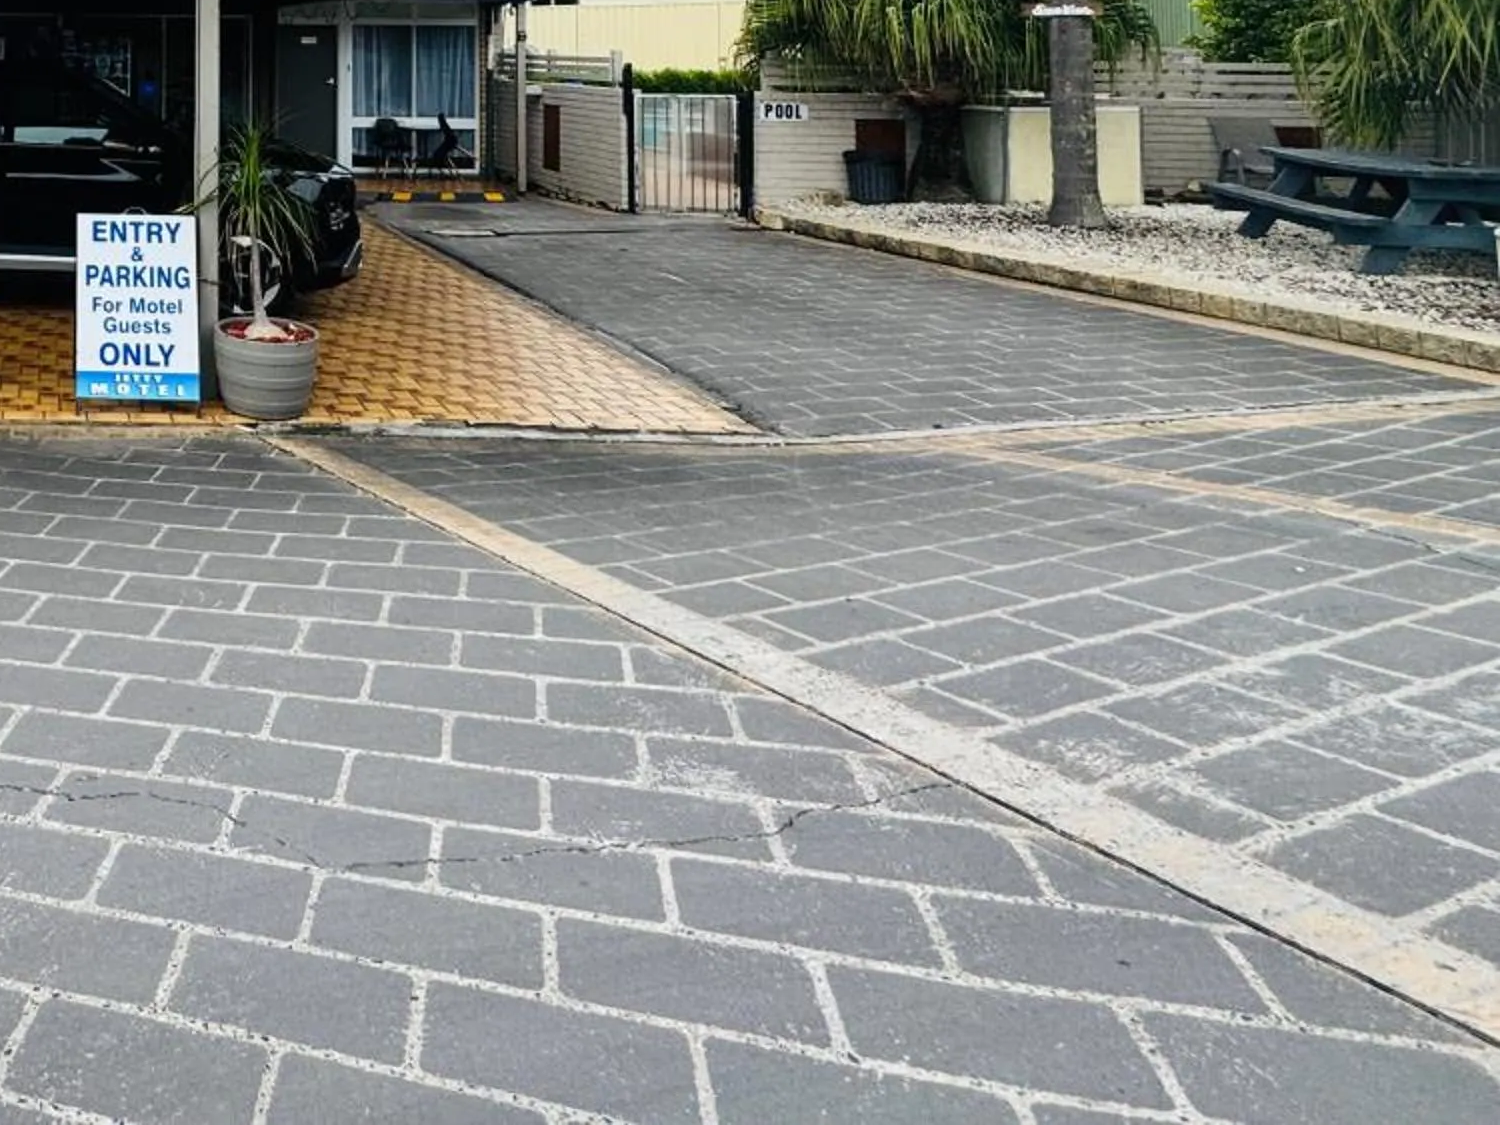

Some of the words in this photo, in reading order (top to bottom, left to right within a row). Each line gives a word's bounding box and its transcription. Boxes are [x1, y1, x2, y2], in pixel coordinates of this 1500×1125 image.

[764, 103, 802, 119] POOL
[92, 221, 181, 244] ENTRY
[131, 247, 144, 261] &
[85, 265, 191, 289] PARKING
[92, 296, 123, 313] For
[129, 297, 183, 314] Motel
[104, 317, 171, 334] Guests
[100, 342, 175, 367] ONLY
[90, 383, 185, 396] MOTEL
